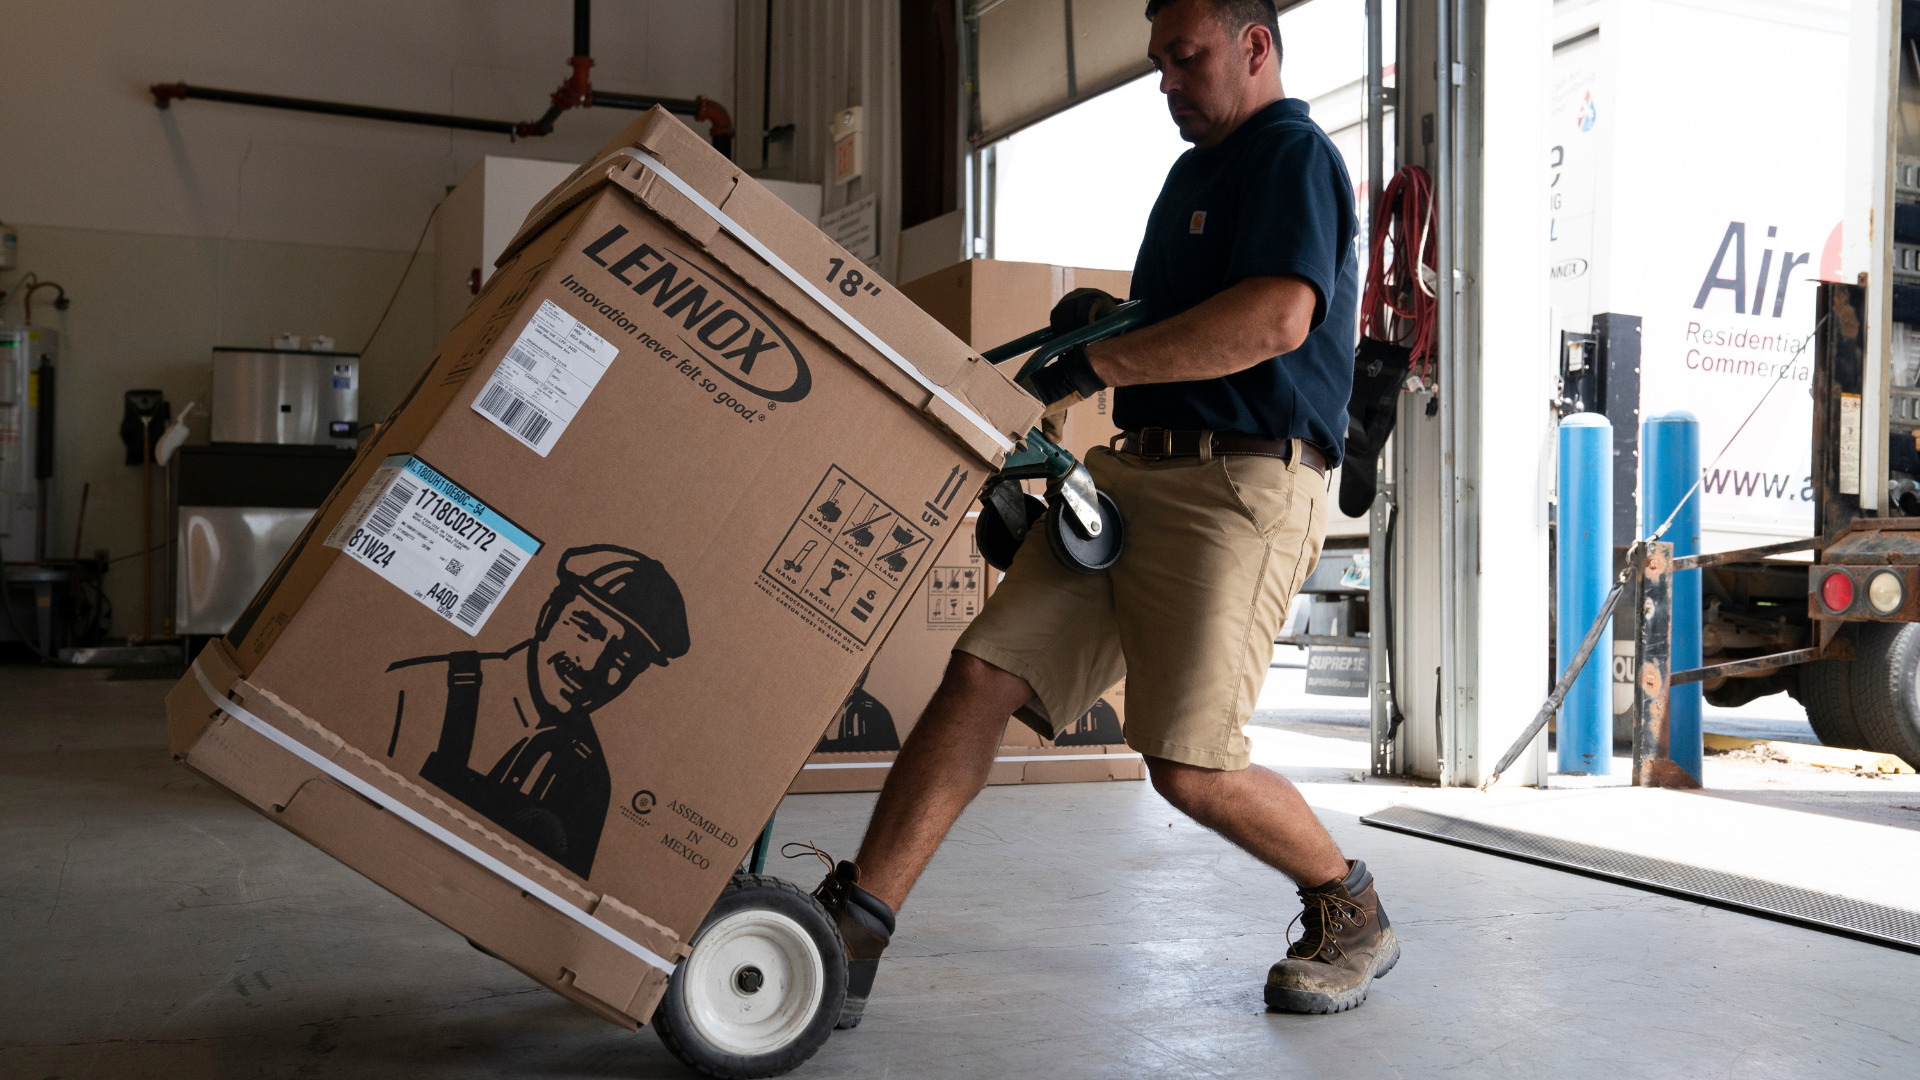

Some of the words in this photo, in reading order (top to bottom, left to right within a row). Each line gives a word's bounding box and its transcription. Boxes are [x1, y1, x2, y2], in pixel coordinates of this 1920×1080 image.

[1692, 221, 1810, 318] Air
[582, 224, 780, 375] LENNOX
[560, 274, 638, 335] Innovation
[637, 331, 678, 363] never
[675, 359, 702, 381] felt
[699, 378, 718, 393] so
[1686, 321, 1810, 354] Residential
[1097, 391, 1106, 415] 5801
[403, 457, 486, 517] ML180UH110E60C-54
[415, 487, 497, 552] 1718C02772
[921, 510, 941, 528] UP
[348, 528, 396, 569] 81W24
[808, 513, 833, 534] SPADE
[844, 540, 865, 558] FORK
[874, 563, 899, 583] CLAMP
[414, 589, 423, 599] Line
[426, 582, 459, 610] A400
[758, 574, 781, 592] CLAIMS
[781, 591, 816, 618] PROCEDURE
[817, 617, 842, 637] LOCATED
[843, 635, 852, 644] ON
[852, 642, 864, 652] TOP
[775, 567, 797, 586] HAND
[804, 588, 836, 613] FRAGILE
[866, 589, 878, 601] 6
[776, 597, 800, 616] CARTON
[800, 614, 817, 628] MUST
[826, 631, 841, 645] KEPT
[1309, 655, 1366, 671] SUPREME
[667, 799, 738, 848] ASSEMBLED
[686, 830, 703, 845] IN
[660, 833, 710, 870] MEXICO
